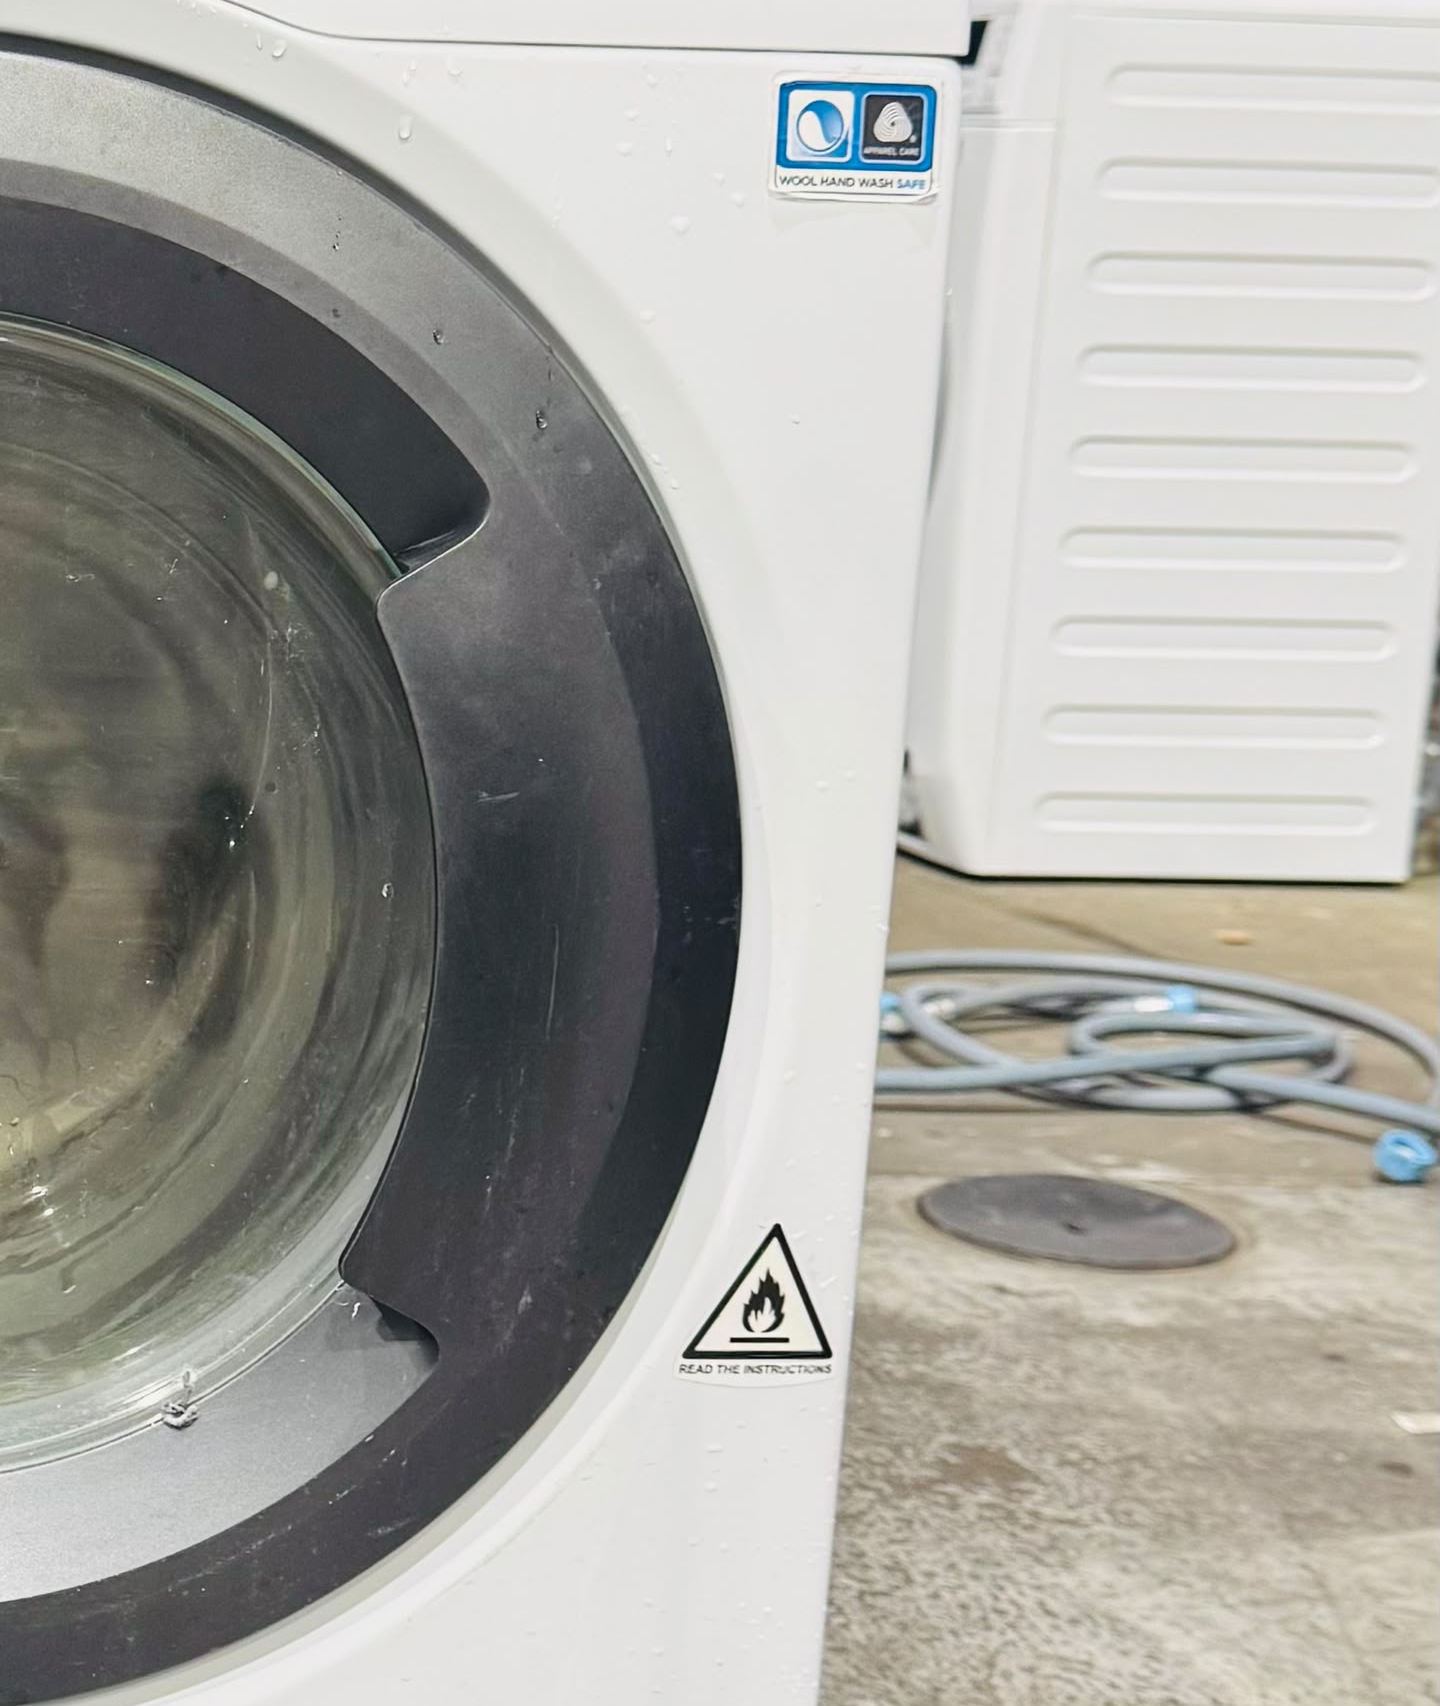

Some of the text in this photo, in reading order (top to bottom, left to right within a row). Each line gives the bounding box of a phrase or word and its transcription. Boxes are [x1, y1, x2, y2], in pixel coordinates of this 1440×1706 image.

[779, 175, 927, 190] WOOL HAND WASH SAFE
[679, 1364, 832, 1375] READ THE INSTRUCTIONS
